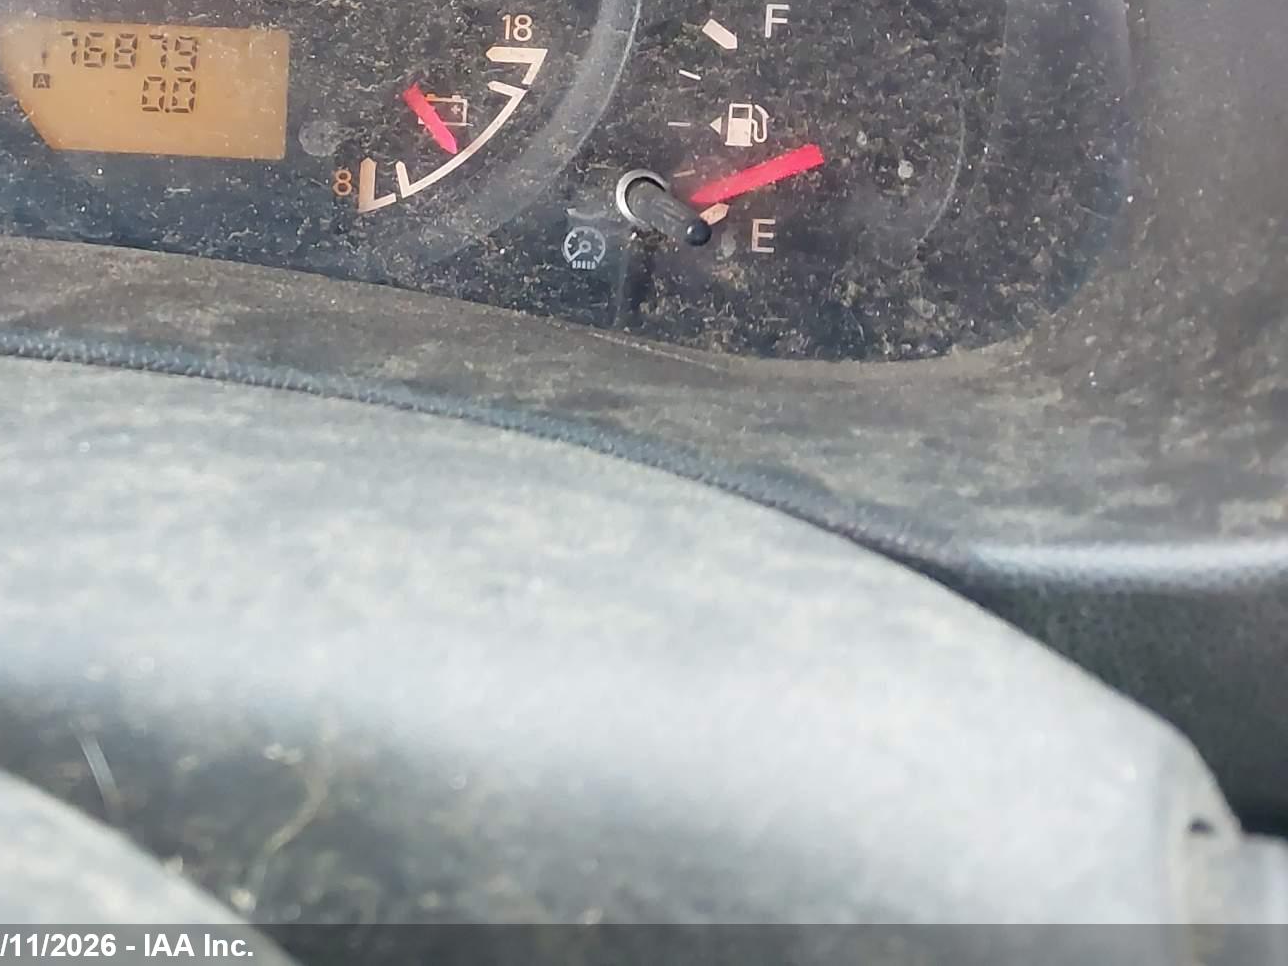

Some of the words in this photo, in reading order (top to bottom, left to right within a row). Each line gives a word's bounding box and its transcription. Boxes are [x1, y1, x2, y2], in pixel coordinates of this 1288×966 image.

[501, 15, 533, 42] 18
[764, 4, 790, 38] F
[333, 171, 353, 197] 8
[752, 218, 776, 253] E
